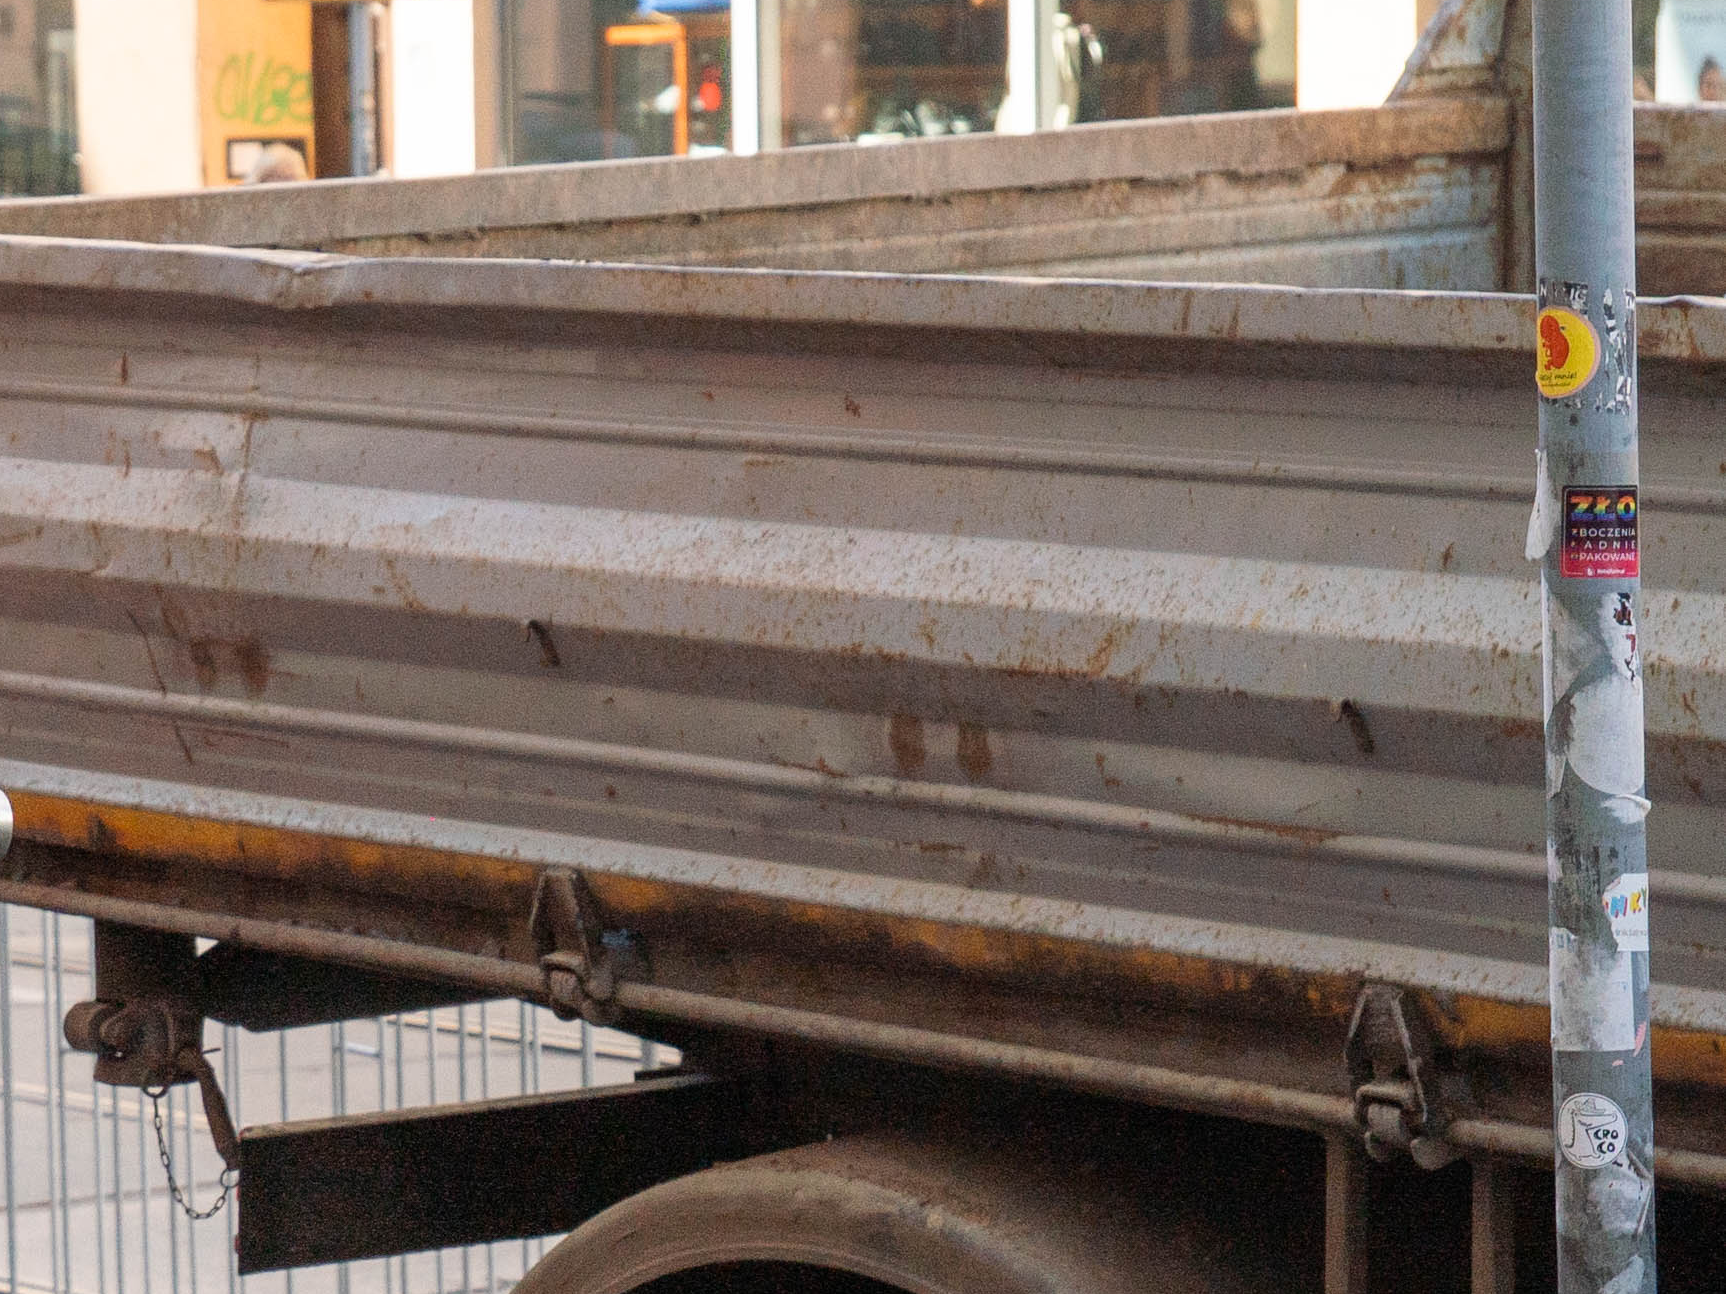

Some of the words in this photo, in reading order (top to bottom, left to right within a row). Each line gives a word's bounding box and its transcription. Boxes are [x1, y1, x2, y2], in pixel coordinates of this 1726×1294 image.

[1570, 496, 1636, 521] ZŁO
[1593, 1128, 1619, 1141] CRO
[1597, 1141, 1616, 1154] CO
